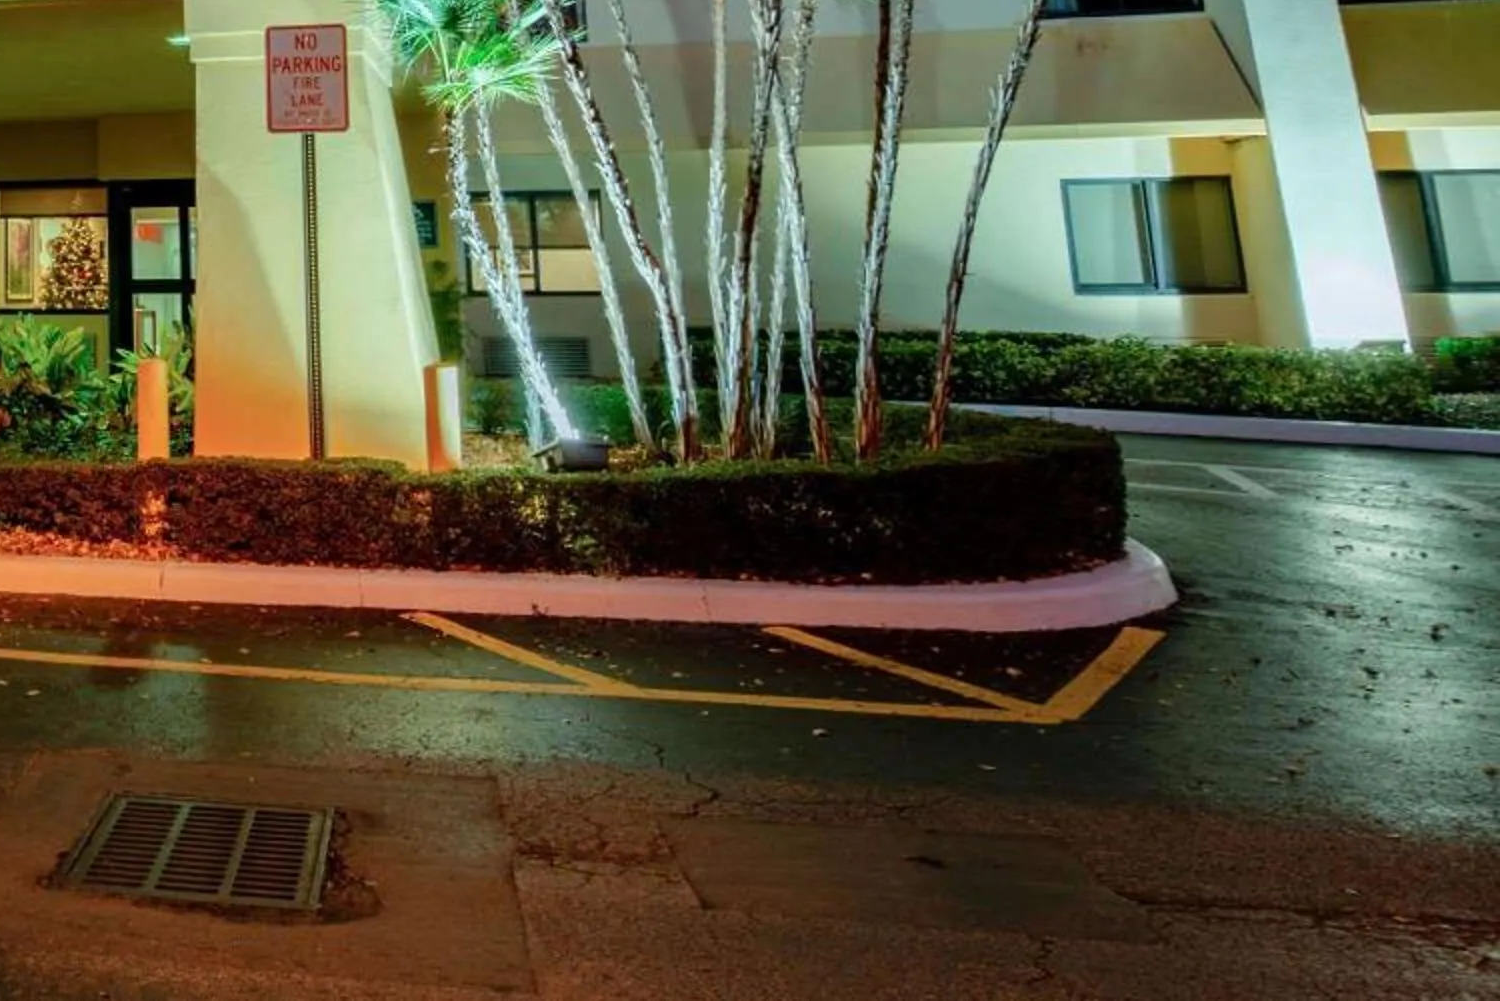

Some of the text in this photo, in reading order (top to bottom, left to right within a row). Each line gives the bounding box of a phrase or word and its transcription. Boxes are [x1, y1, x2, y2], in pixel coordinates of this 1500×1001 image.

[294, 32, 318, 51] NO
[272, 54, 342, 75] PARKING
[293, 76, 322, 91] FIRE
[291, 93, 324, 108] LANE
